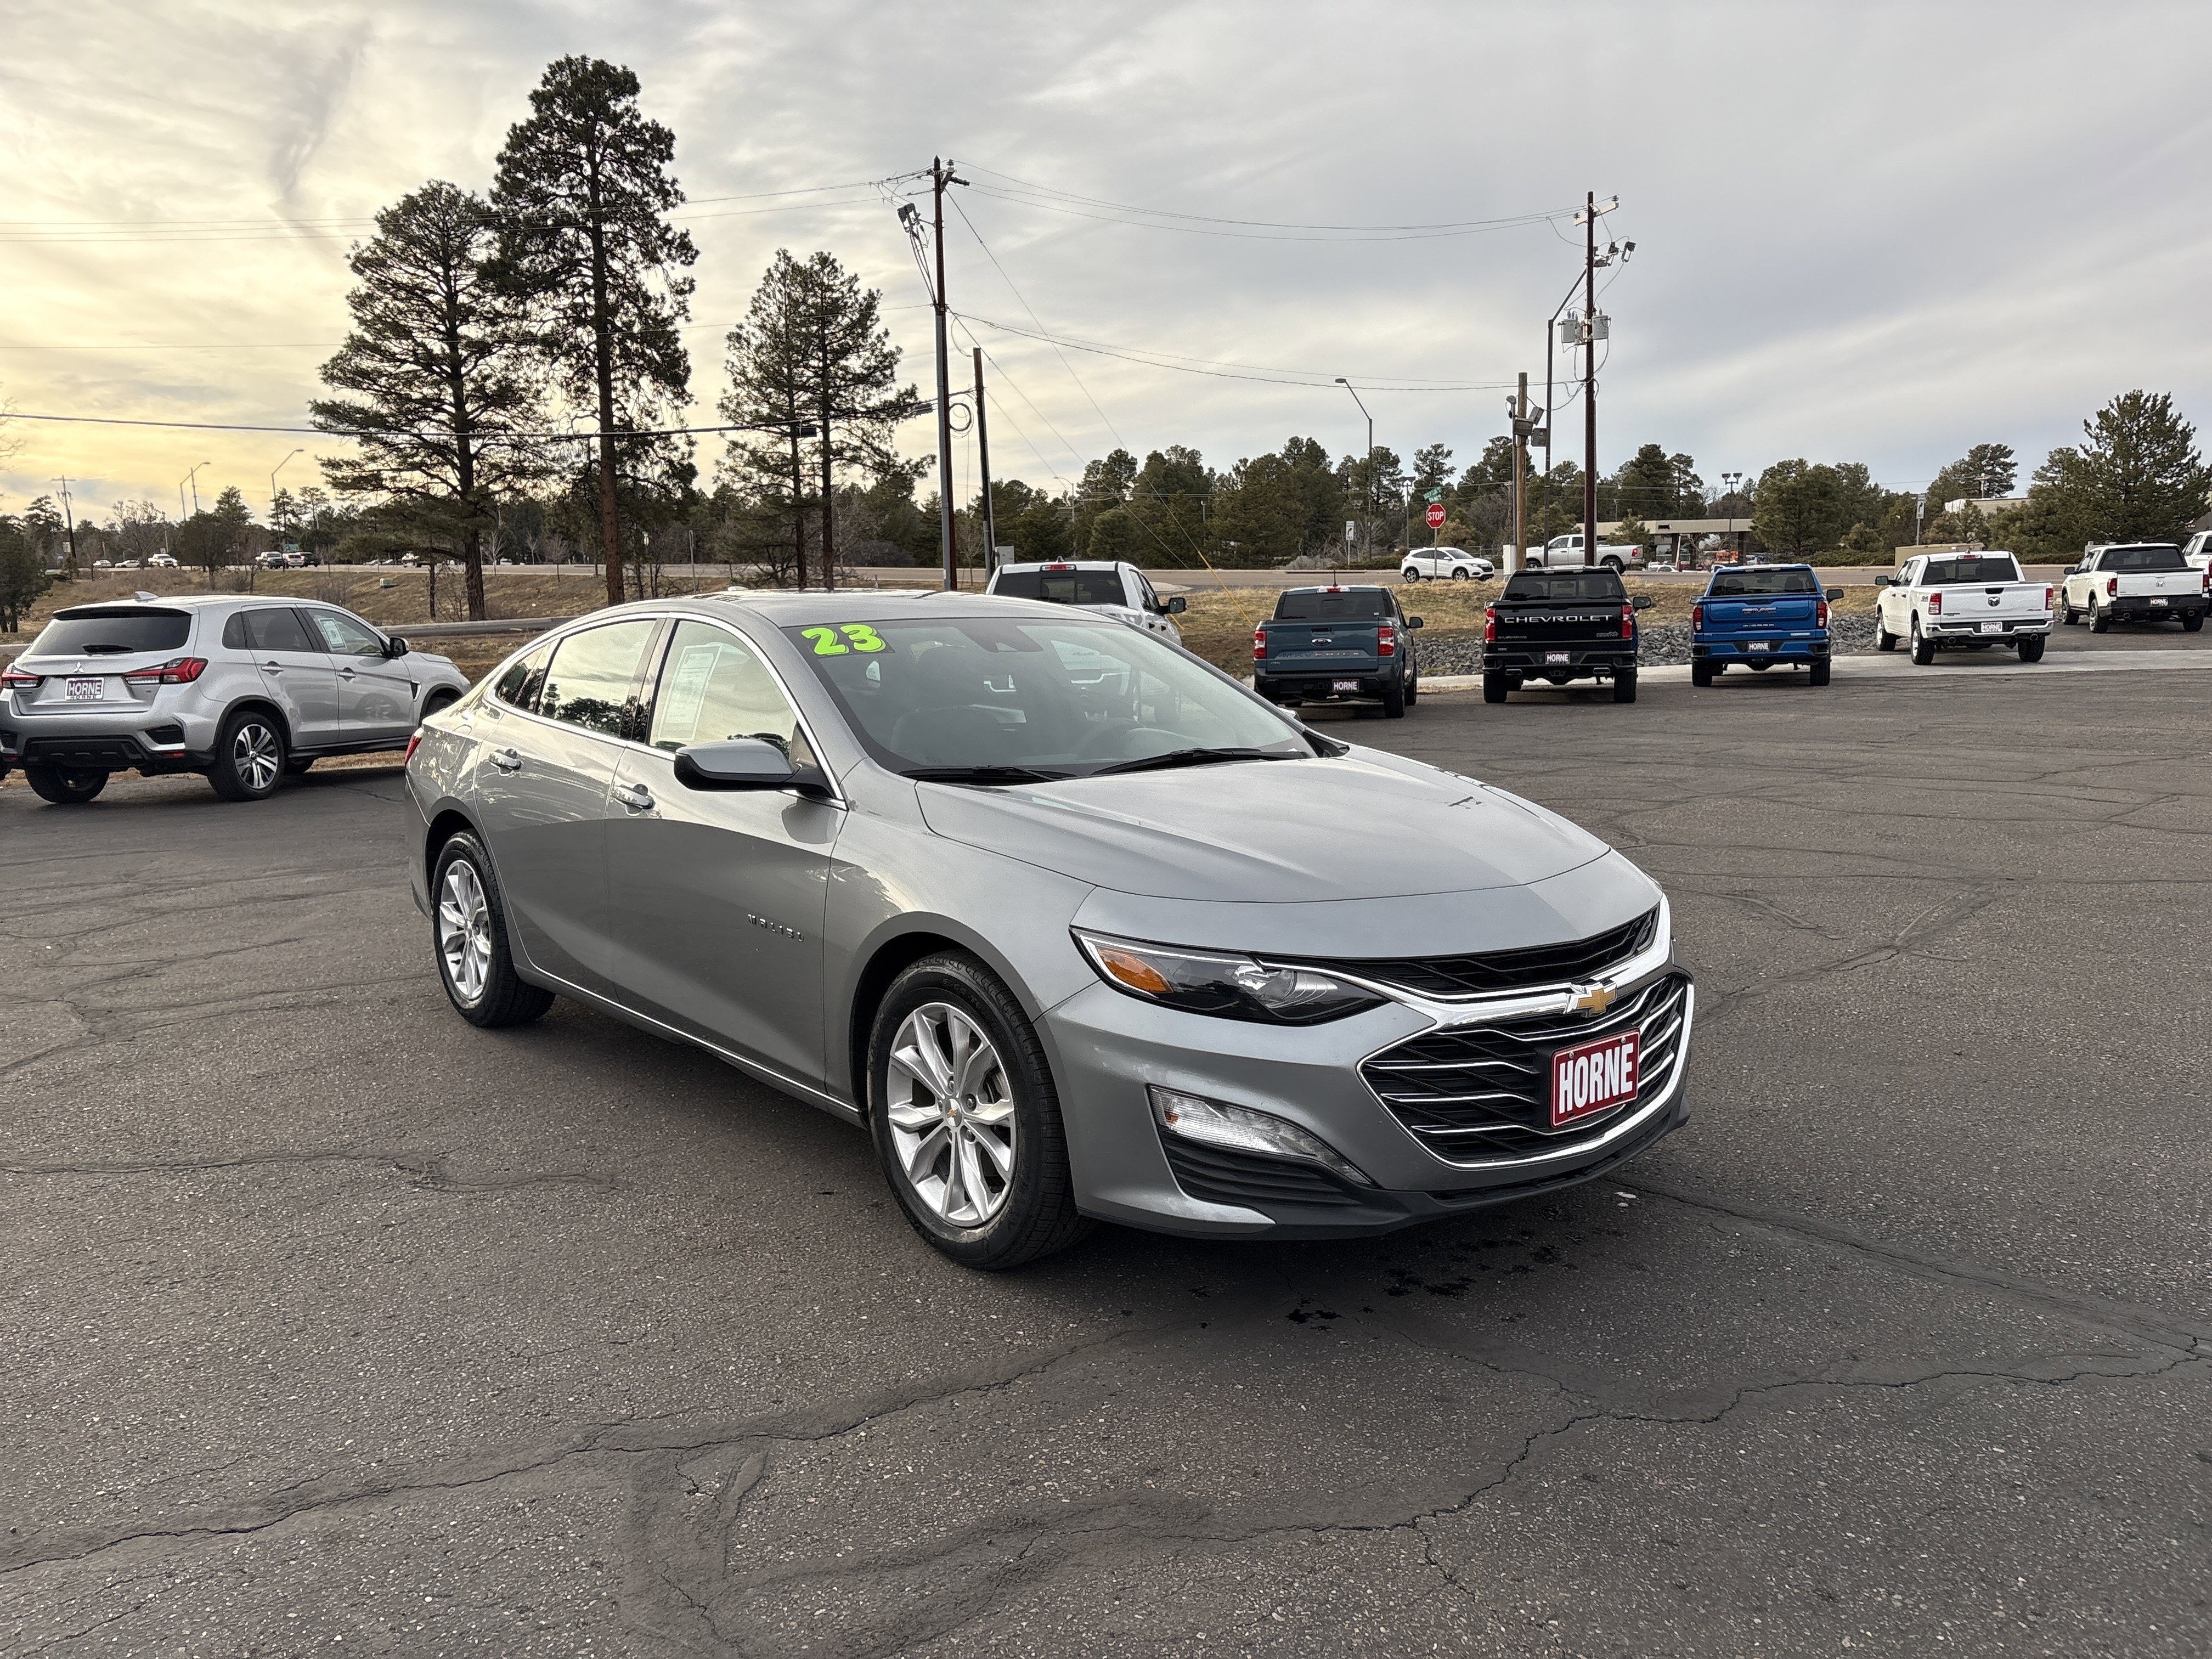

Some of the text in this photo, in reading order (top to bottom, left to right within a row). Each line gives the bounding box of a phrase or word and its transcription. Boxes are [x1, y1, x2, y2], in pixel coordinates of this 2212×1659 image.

[1427, 511, 1444, 521] STOP
[1504, 614, 1612, 623] CHEVROLET
[801, 624, 886, 656] 23
[1547, 653, 1569, 662] HORNE
[68, 682, 101, 696] HORNE
[1333, 681, 1358, 691] HORNE
[748, 914, 805, 943] MALIBU
[1559, 1042, 1634, 1114] HORNE
